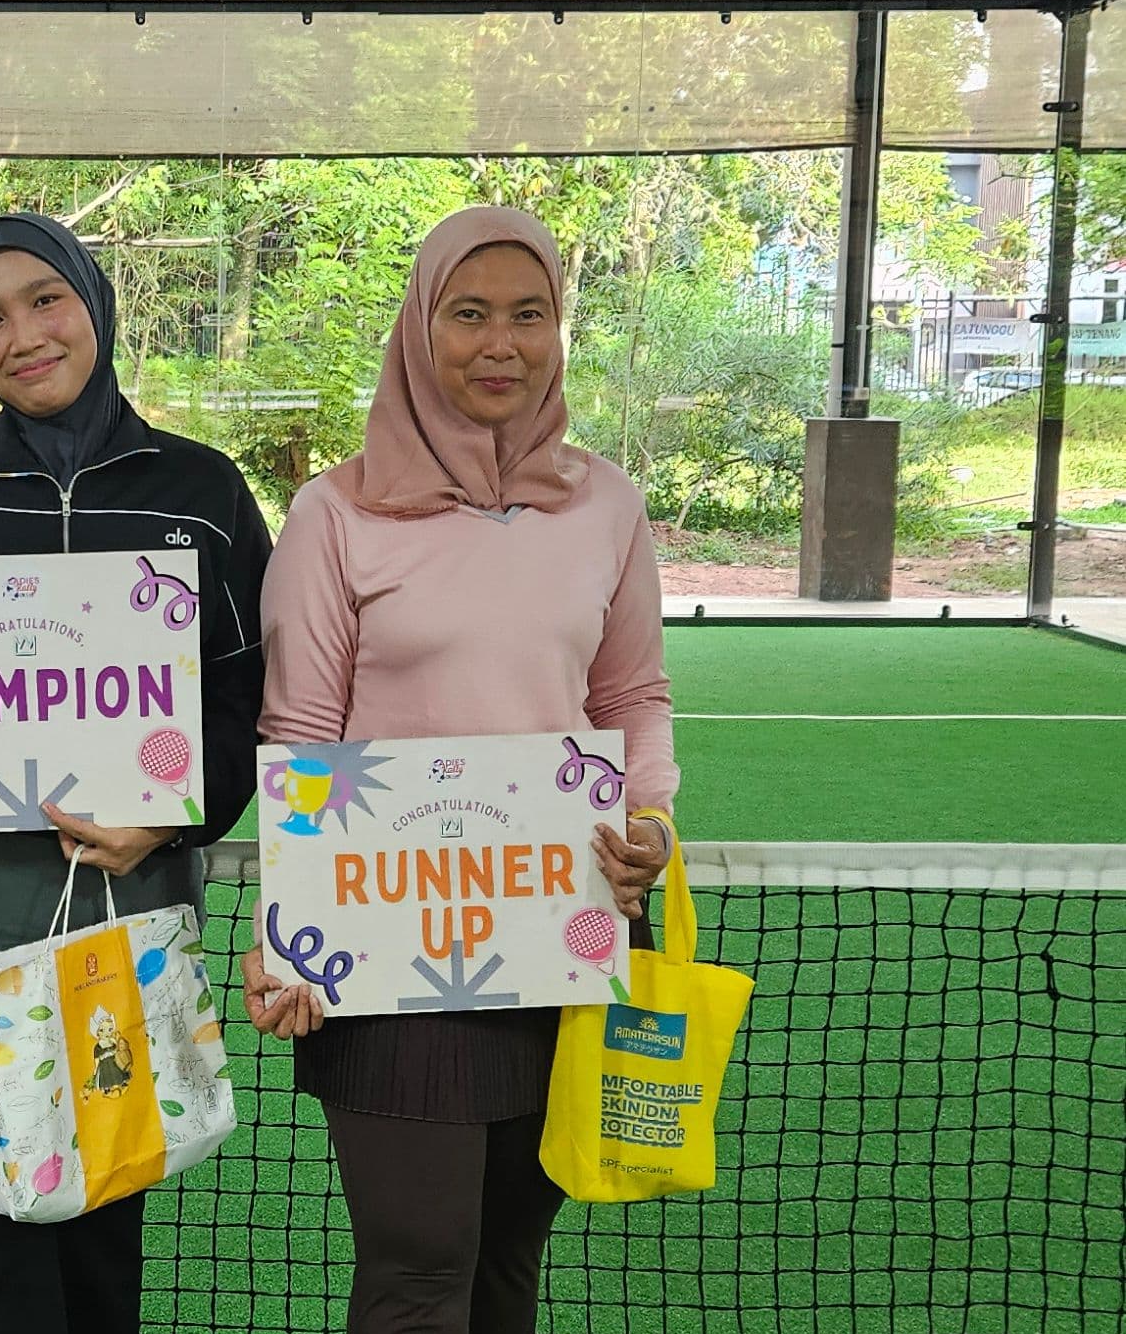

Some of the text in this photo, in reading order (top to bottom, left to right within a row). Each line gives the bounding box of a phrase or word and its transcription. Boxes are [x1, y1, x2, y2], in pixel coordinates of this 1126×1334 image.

[968, 323, 1015, 336] TUNGGU
[165, 527, 192, 546] alo
[334, 844, 575, 906] RUNNER
[421, 905, 493, 960] UP
[602, 1074, 703, 1098] MFORTABLE
[601, 1117, 686, 1141] ROTECTOR
